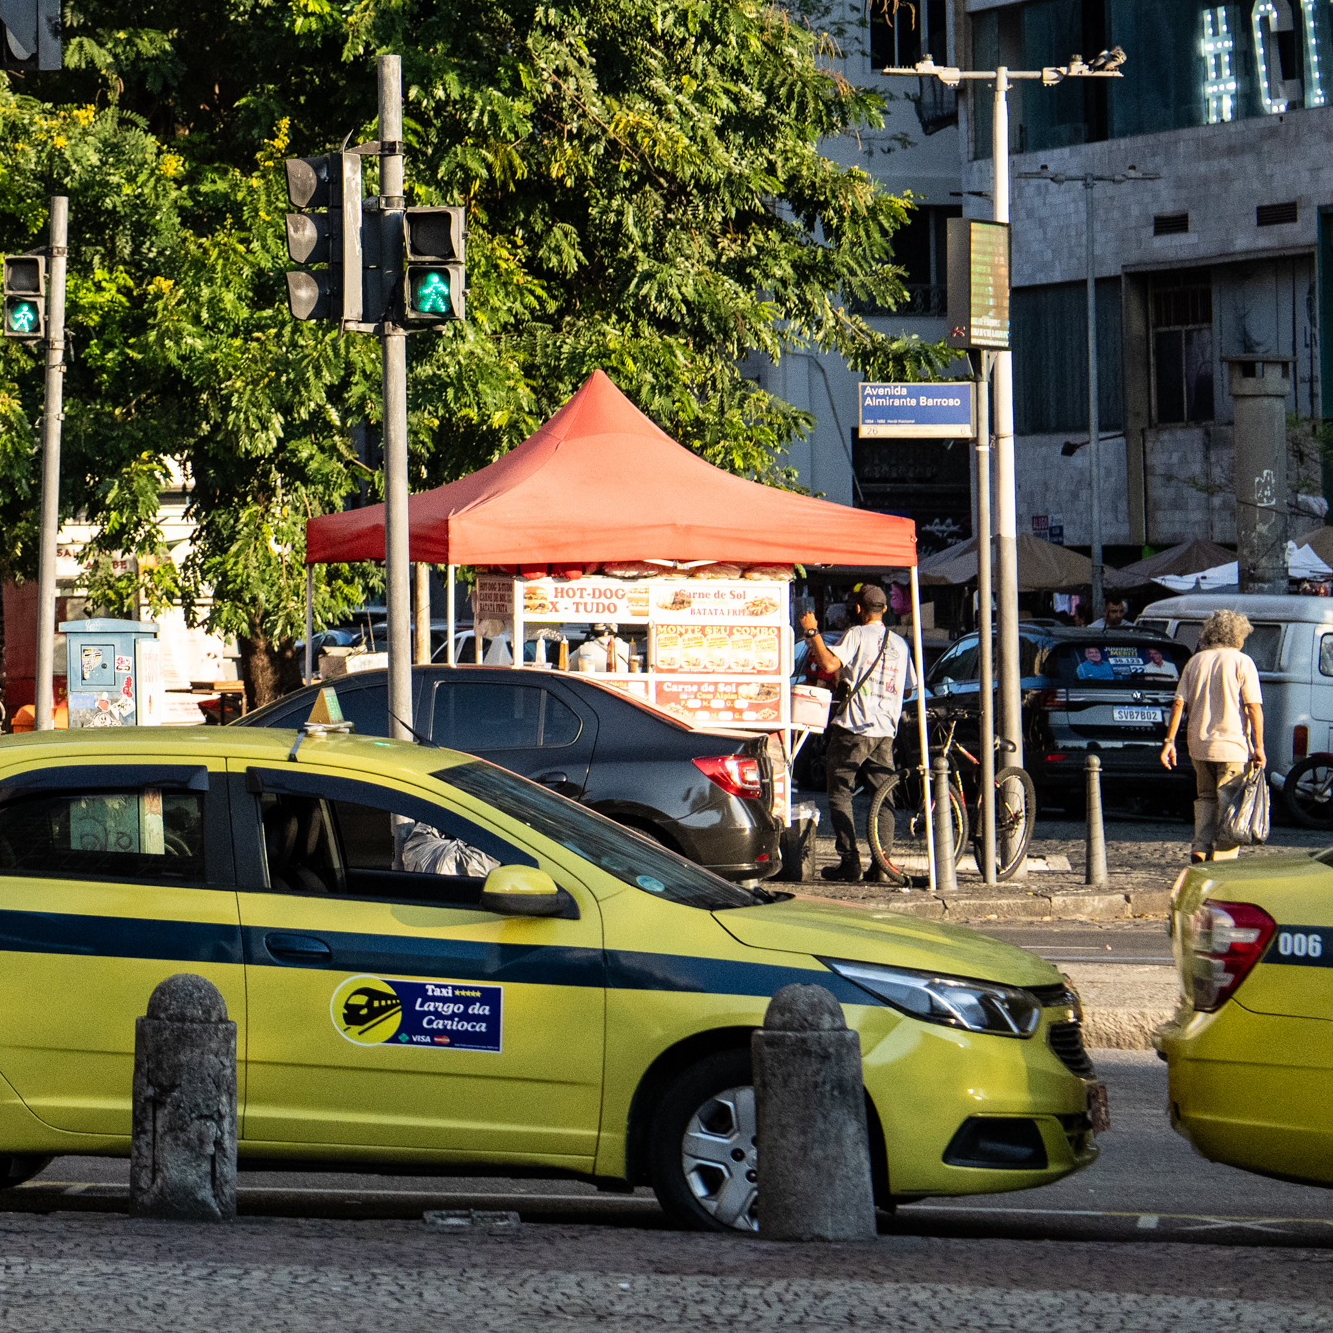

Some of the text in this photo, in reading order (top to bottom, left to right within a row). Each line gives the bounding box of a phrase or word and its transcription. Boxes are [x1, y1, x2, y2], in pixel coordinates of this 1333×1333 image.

[864, 386, 907, 395] Avenida
[864, 396, 960, 406] Almirante Barroso
[553, 586, 626, 599] HOT-DOG
[678, 589, 746, 600] Carne de Sol
[549, 601, 560, 613] X
[573, 602, 618, 614] TUDO
[690, 608, 725, 616] BATATA
[656, 625, 778, 635] MONTE SEU COMBO
[663, 682, 736, 692] Carne de Sol
[1278, 932, 1322, 957] 006
[425, 985, 453, 997] Taxi
[415, 998, 490, 1015] Largo da
[422, 1016, 487, 1032] Carioca
[411, 1034, 431, 1043] VISA
